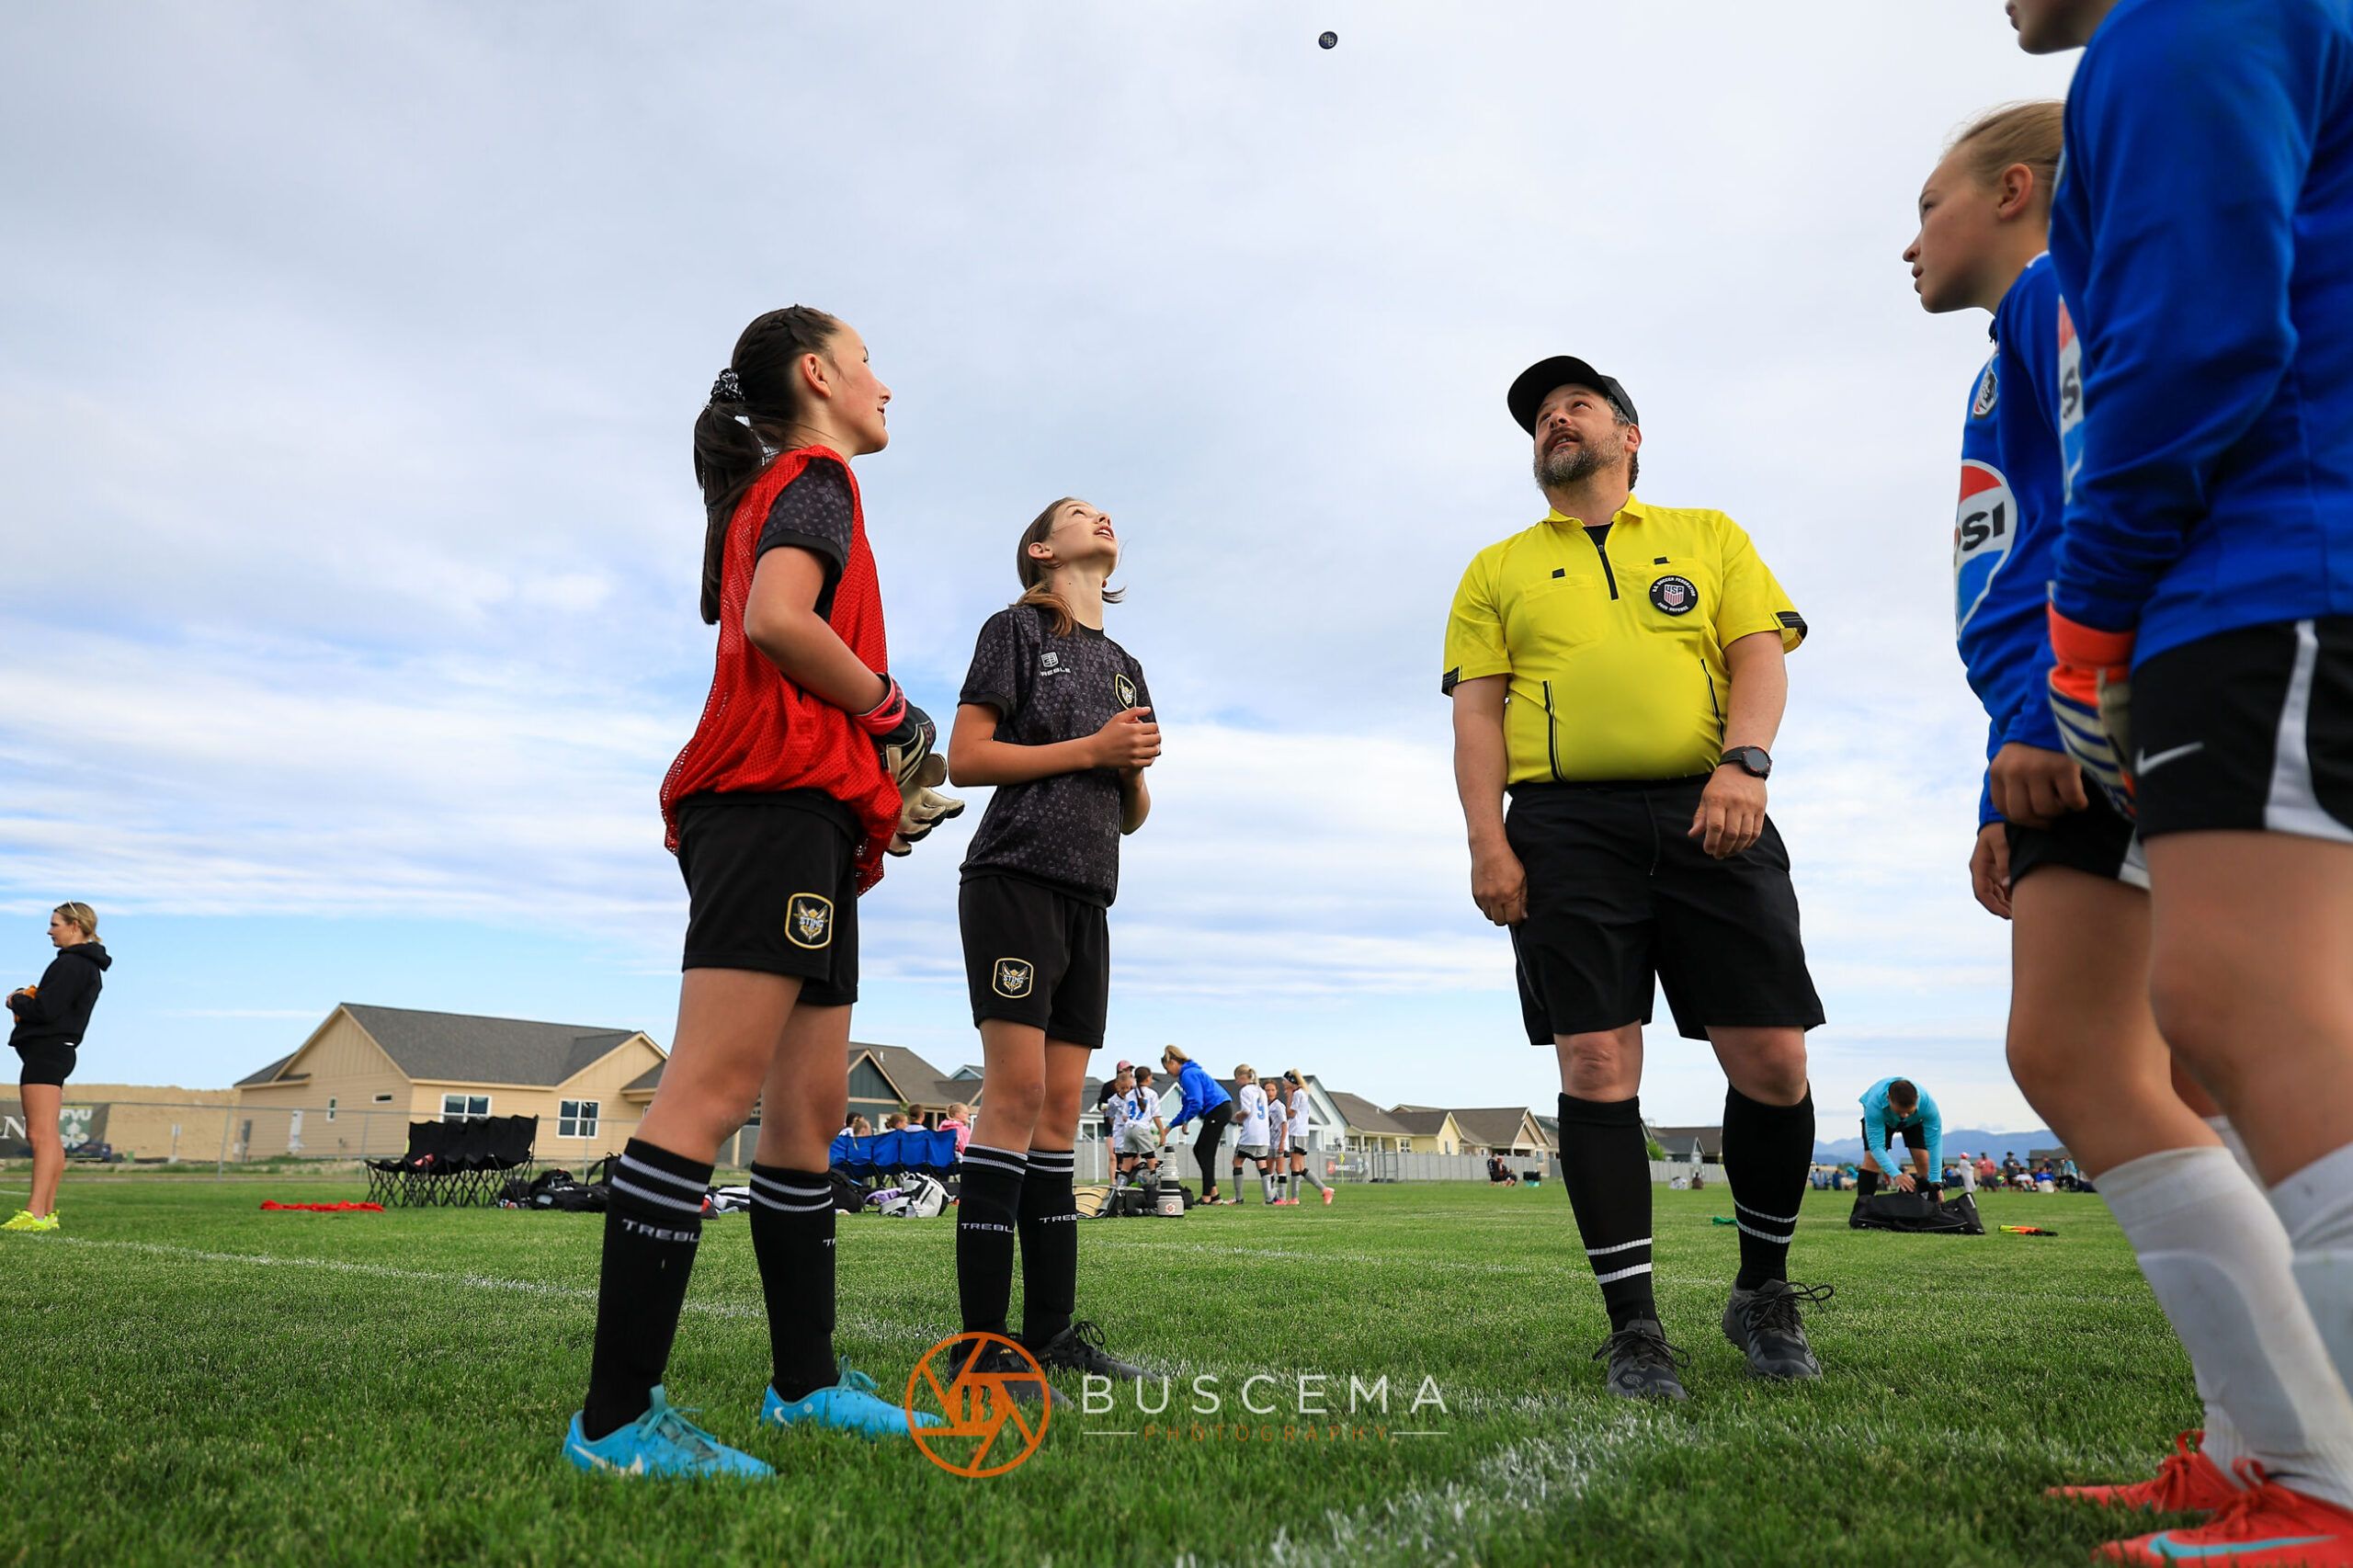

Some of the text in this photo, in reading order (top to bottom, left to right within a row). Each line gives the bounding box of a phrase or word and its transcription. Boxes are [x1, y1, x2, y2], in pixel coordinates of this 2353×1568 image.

[1955, 501, 2006, 551] SI
[1665, 585, 1683, 595] USA
[800, 916, 824, 928] STING
[1003, 975, 1024, 984] STING
